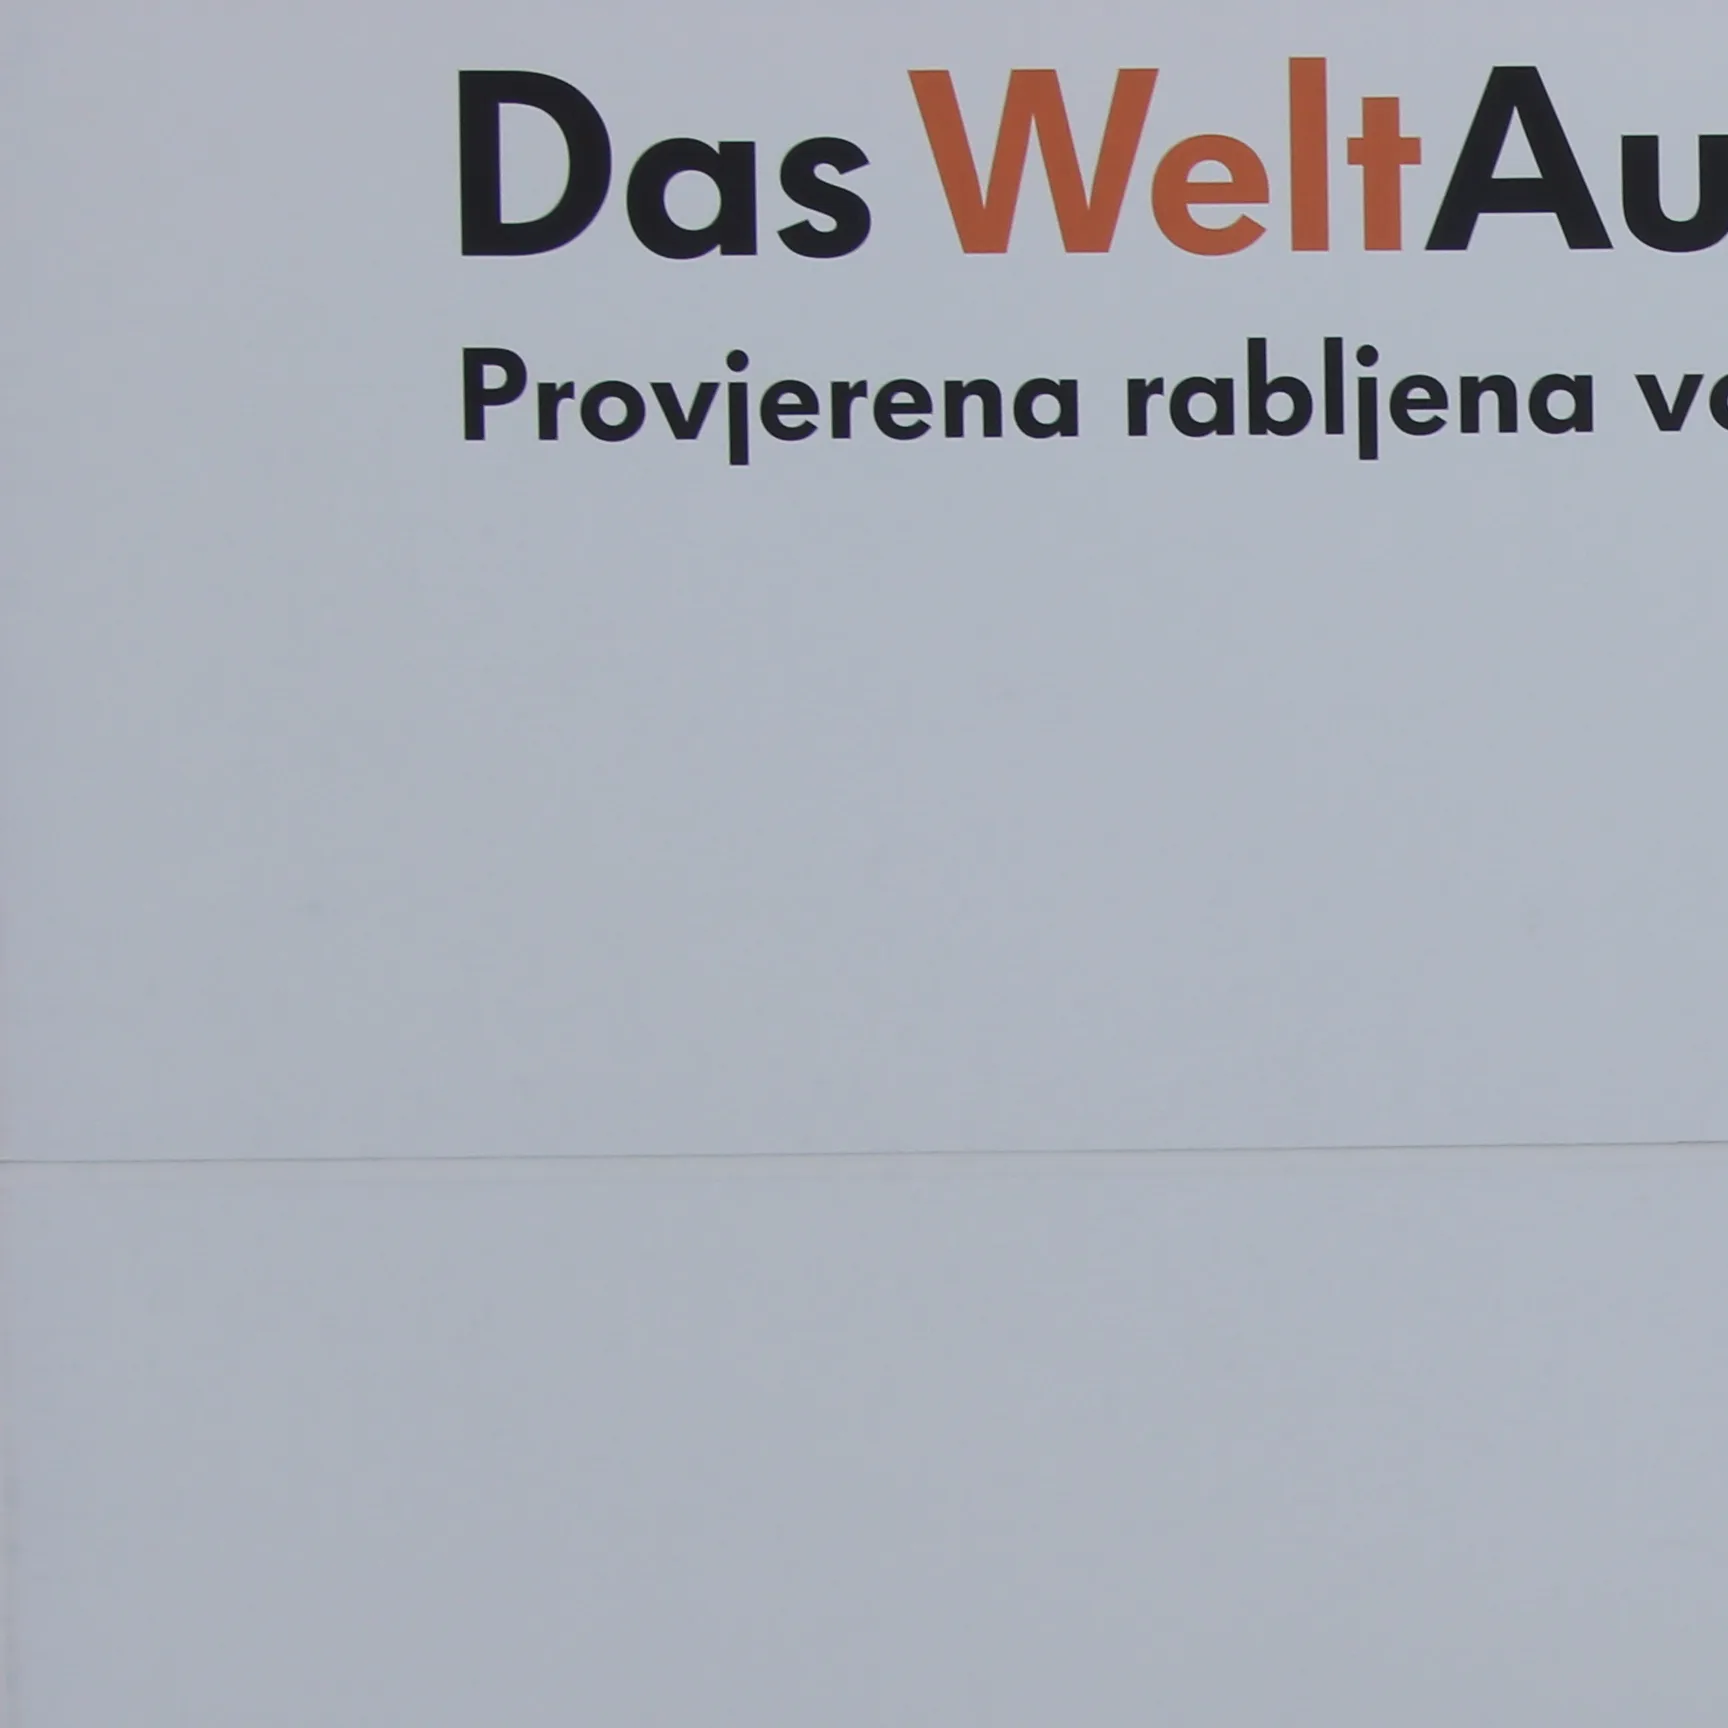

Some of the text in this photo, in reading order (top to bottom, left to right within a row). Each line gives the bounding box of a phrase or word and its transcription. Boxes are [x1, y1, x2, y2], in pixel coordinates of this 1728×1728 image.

[458, 68, 871, 260] Das
[462, 346, 1079, 466] Provjerena
[1127, 336, 1594, 461] rabljena
